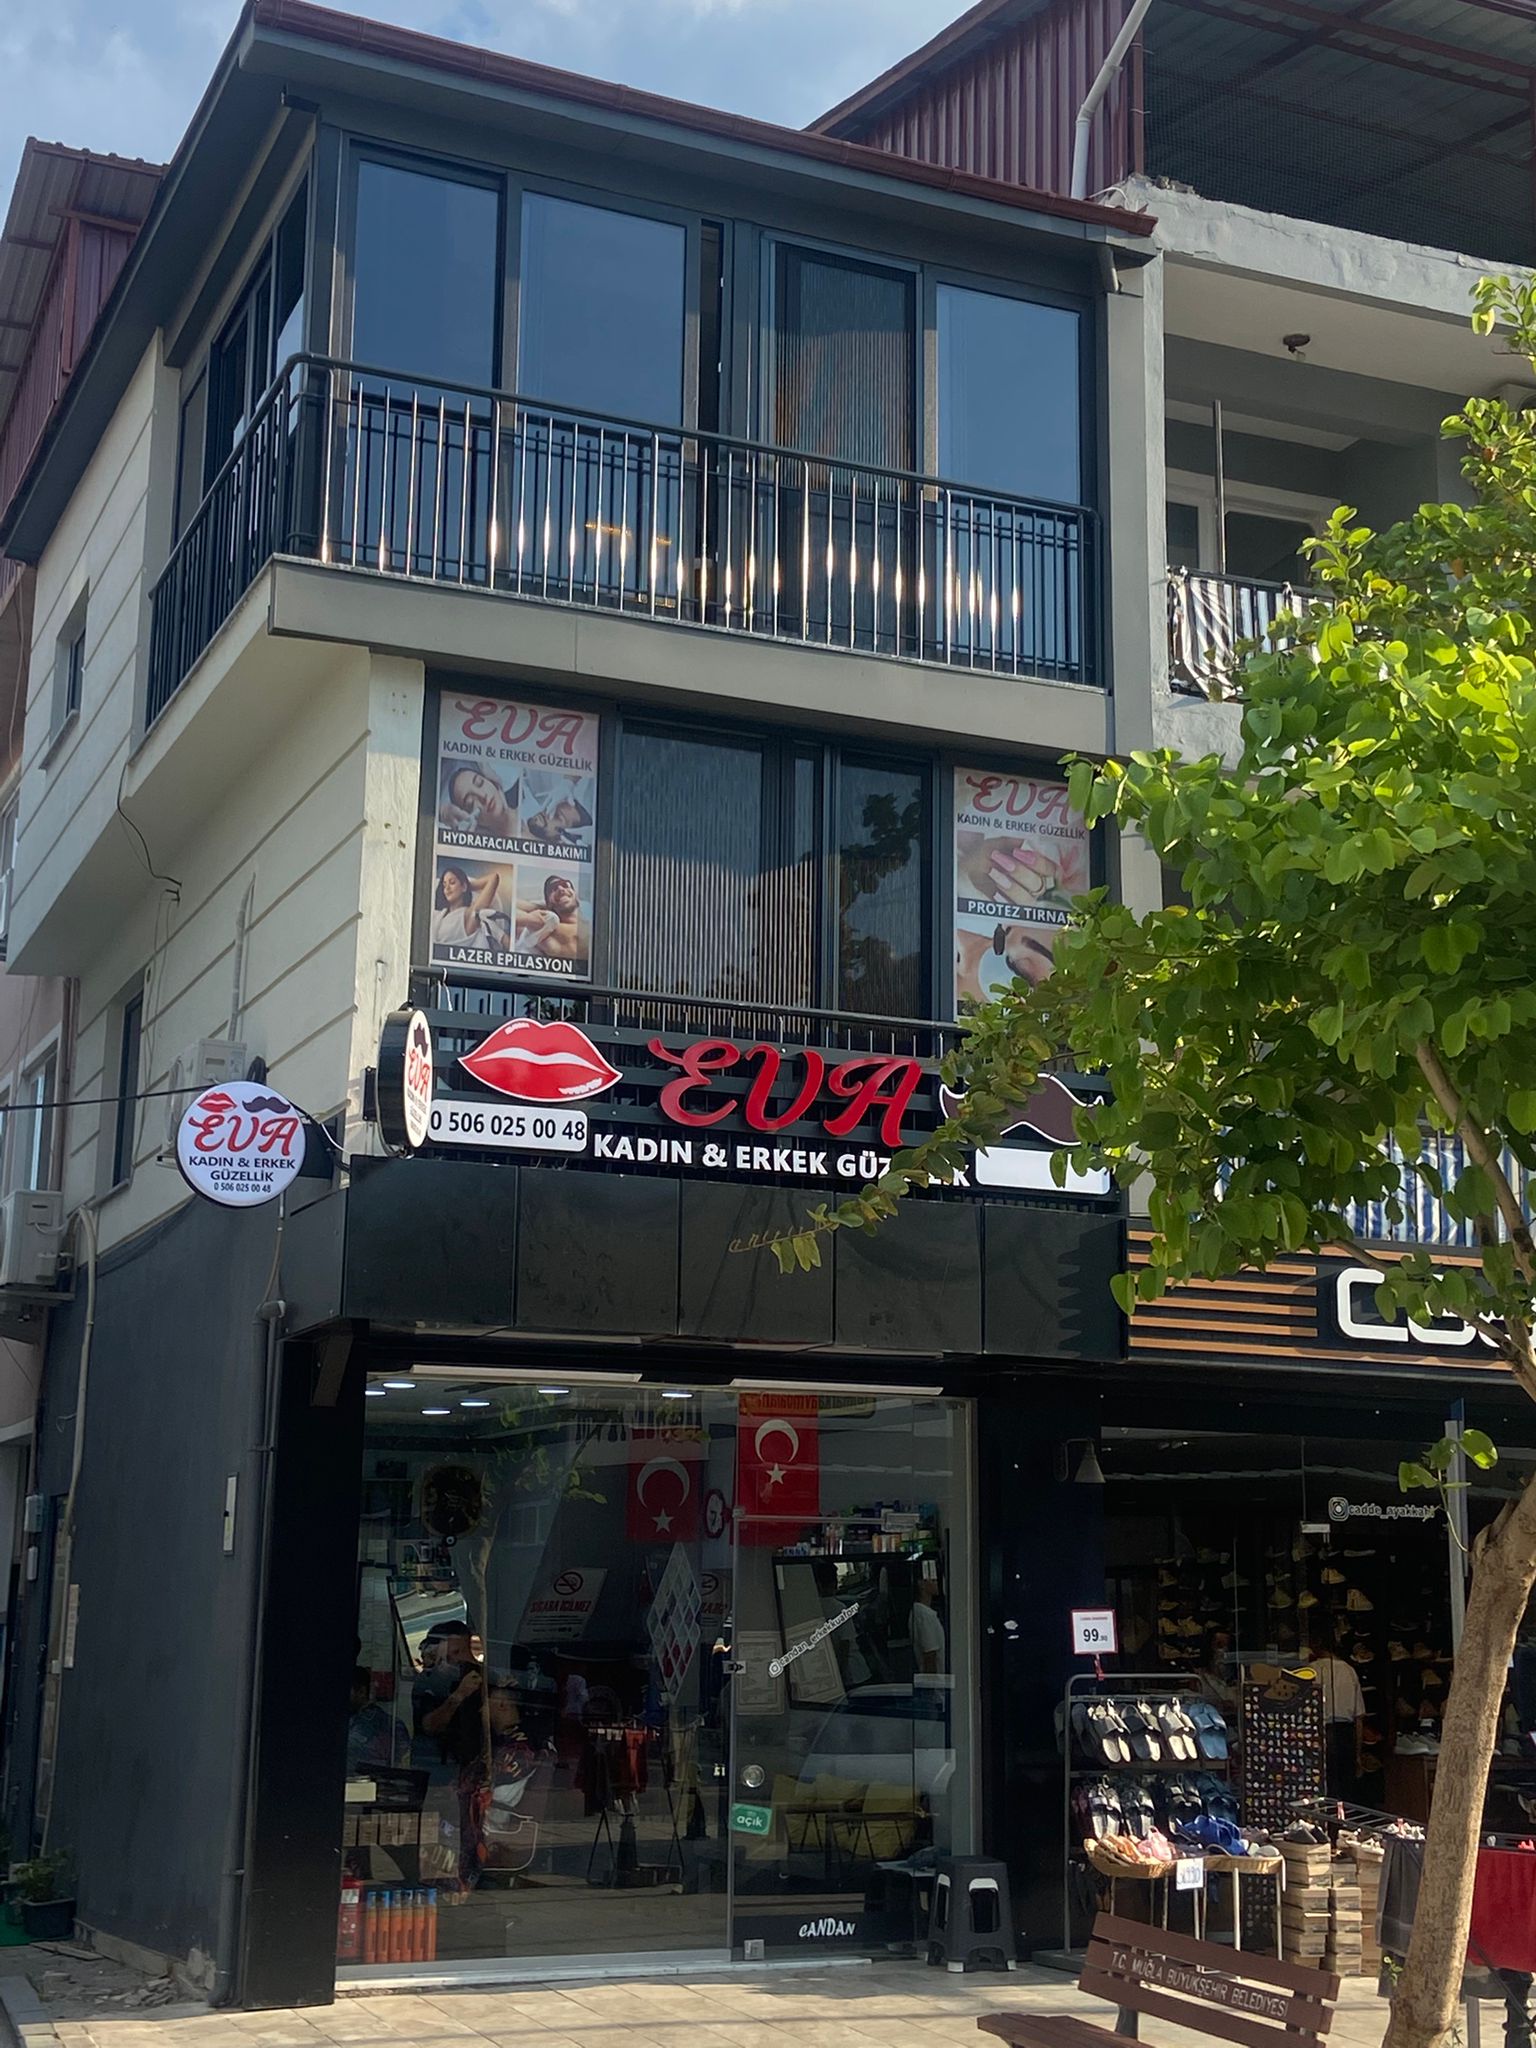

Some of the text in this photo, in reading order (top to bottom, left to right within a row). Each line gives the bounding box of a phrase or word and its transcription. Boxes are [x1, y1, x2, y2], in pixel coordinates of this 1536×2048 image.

[455, 700, 584, 756] EVA
[443, 740, 593, 771] KADIN & ERKEK GÜZELLİK
[966, 776, 1068, 825] EVA
[957, 813, 1085, 840] KADIN & ERKEK GÜZELLİK
[442, 831, 520, 852] HYDRAFACIAL
[547, 845, 587, 861] BAKIMI
[967, 900, 1020, 918] PROTEZ
[449, 947, 494, 965] LAZER
[648, 1037, 922, 1147] EVA
[188, 1114, 299, 1157] EVA
[431, 1110, 442, 1131] 0
[449, 1111, 485, 1134] 506
[491, 1115, 525, 1137] 025
[533, 1118, 556, 1139] 00
[562, 1120, 585, 1141] 48
[189, 1155, 296, 1169] KADIN & ERKEK
[594, 1133, 971, 1187] KADIN & ERKEK GÜZK
[210, 1169, 274, 1182] GÜZELLİK
[213, 1182, 272, 1193] 0 506 025 00 48
[736, 1815, 763, 1828] açık
